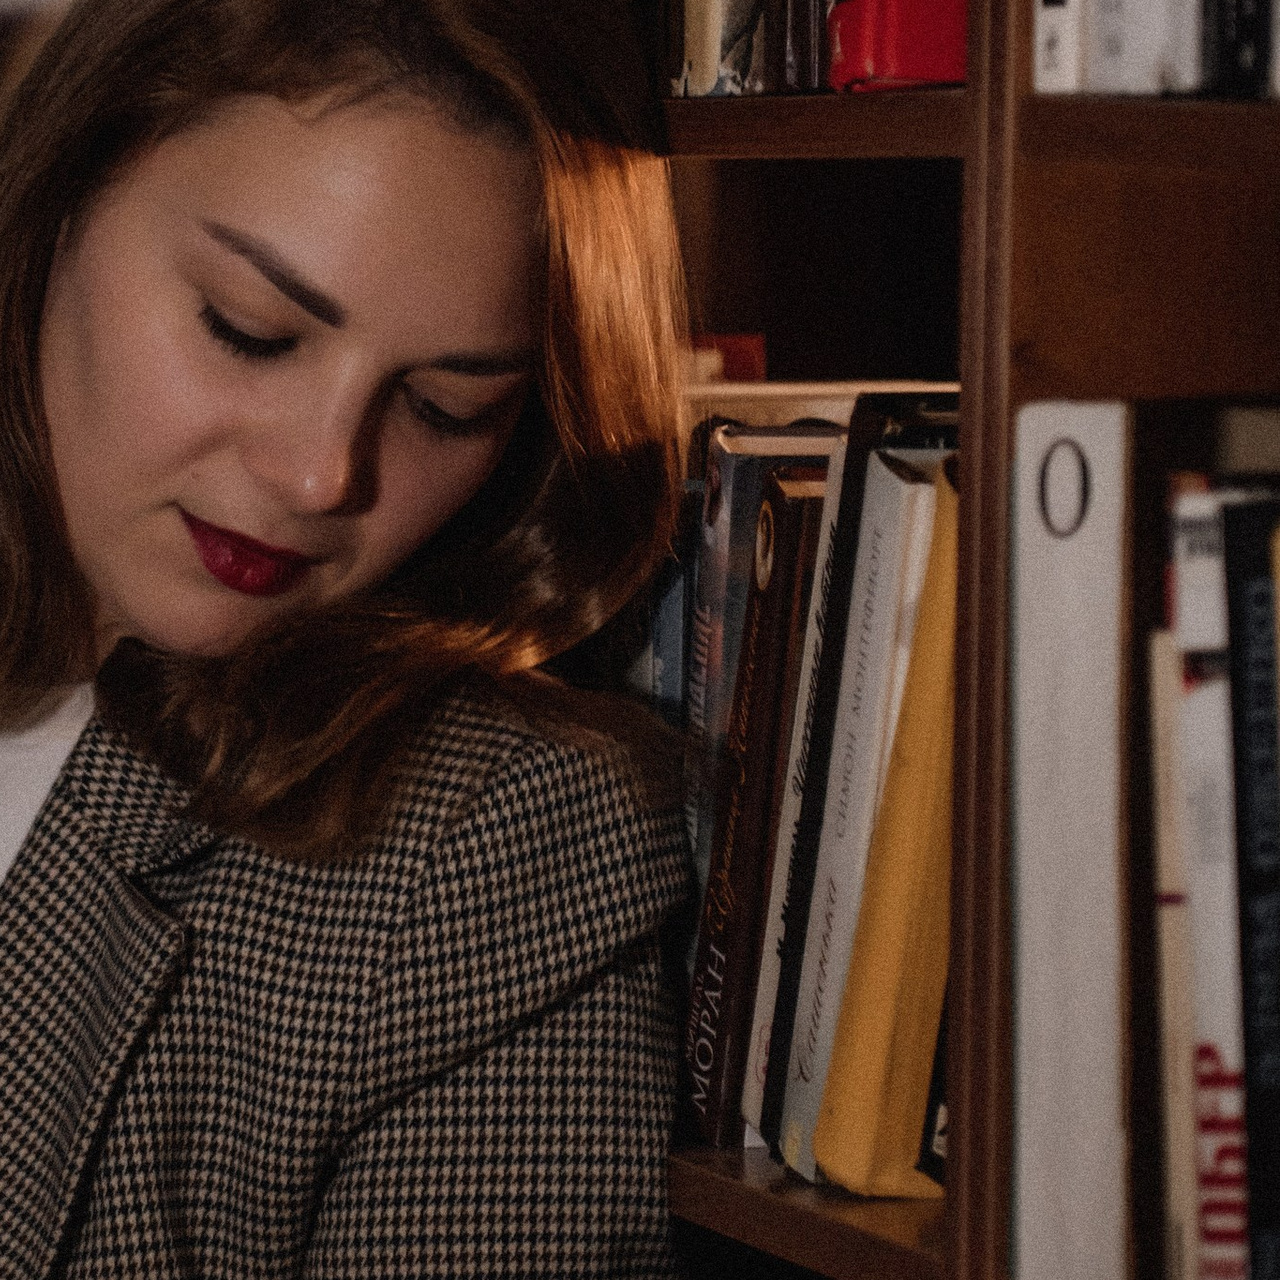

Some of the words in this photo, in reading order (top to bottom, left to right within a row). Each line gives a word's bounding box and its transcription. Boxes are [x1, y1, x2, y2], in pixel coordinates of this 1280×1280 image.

[835, 730, 858, 840] СИМОН
[850, 523, 883, 718] МОНТЕФИОРЕ
[684, 973, 706, 1063] МИШЕЛЬ
[690, 943, 728, 1116] МОРАН
